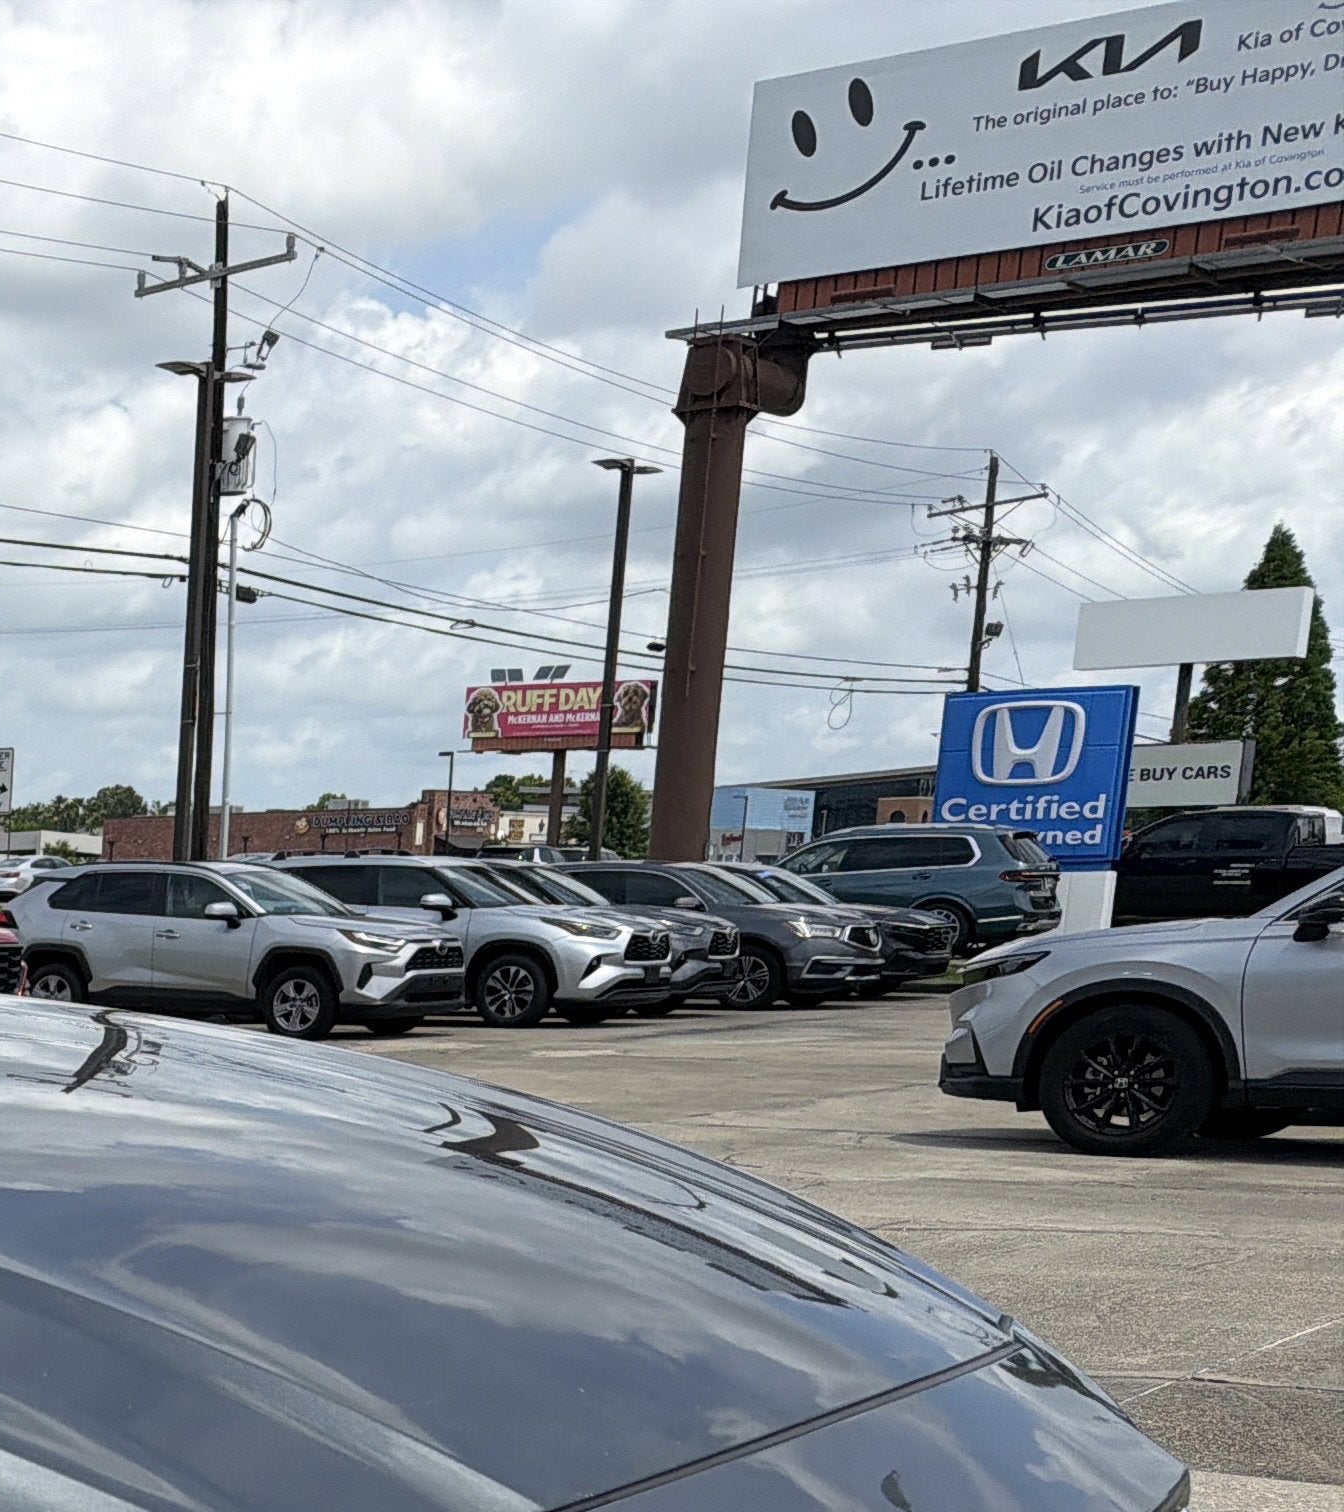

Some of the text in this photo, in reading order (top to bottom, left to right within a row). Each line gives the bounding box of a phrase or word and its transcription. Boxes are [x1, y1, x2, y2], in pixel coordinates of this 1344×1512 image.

[1237, 18, 1344, 51] Kia of Co
[1018, 18, 1203, 91] KIA
[973, 115, 1007, 132] The
[1013, 98, 1087, 125] original
[1092, 91, 1145, 116] place
[1152, 84, 1179, 100] to:
[1241, 61, 1315, 86] Happy,
[920, 170, 1020, 201] Lifetime
[1028, 159, 1063, 183] Oil
[1071, 144, 1184, 177] Changes
[1193, 129, 1252, 157] with
[1261, 122, 1325, 147] New
[1079, 149, 1326, 194] Service must be performed at Kia of Covington
[1031, 167, 1344, 232] KiaofCovington.co
[1055, 242, 1158, 268] LAMAR
[501, 689, 557, 712] RUFF
[508, 711, 601, 724] McKERNAN AND McKERNA
[1139, 766, 1178, 781] BUY
[1182, 764, 1231, 780] CARS
[313, 813, 372, 828] DUMPLING
[941, 793, 1107, 821] Certified
